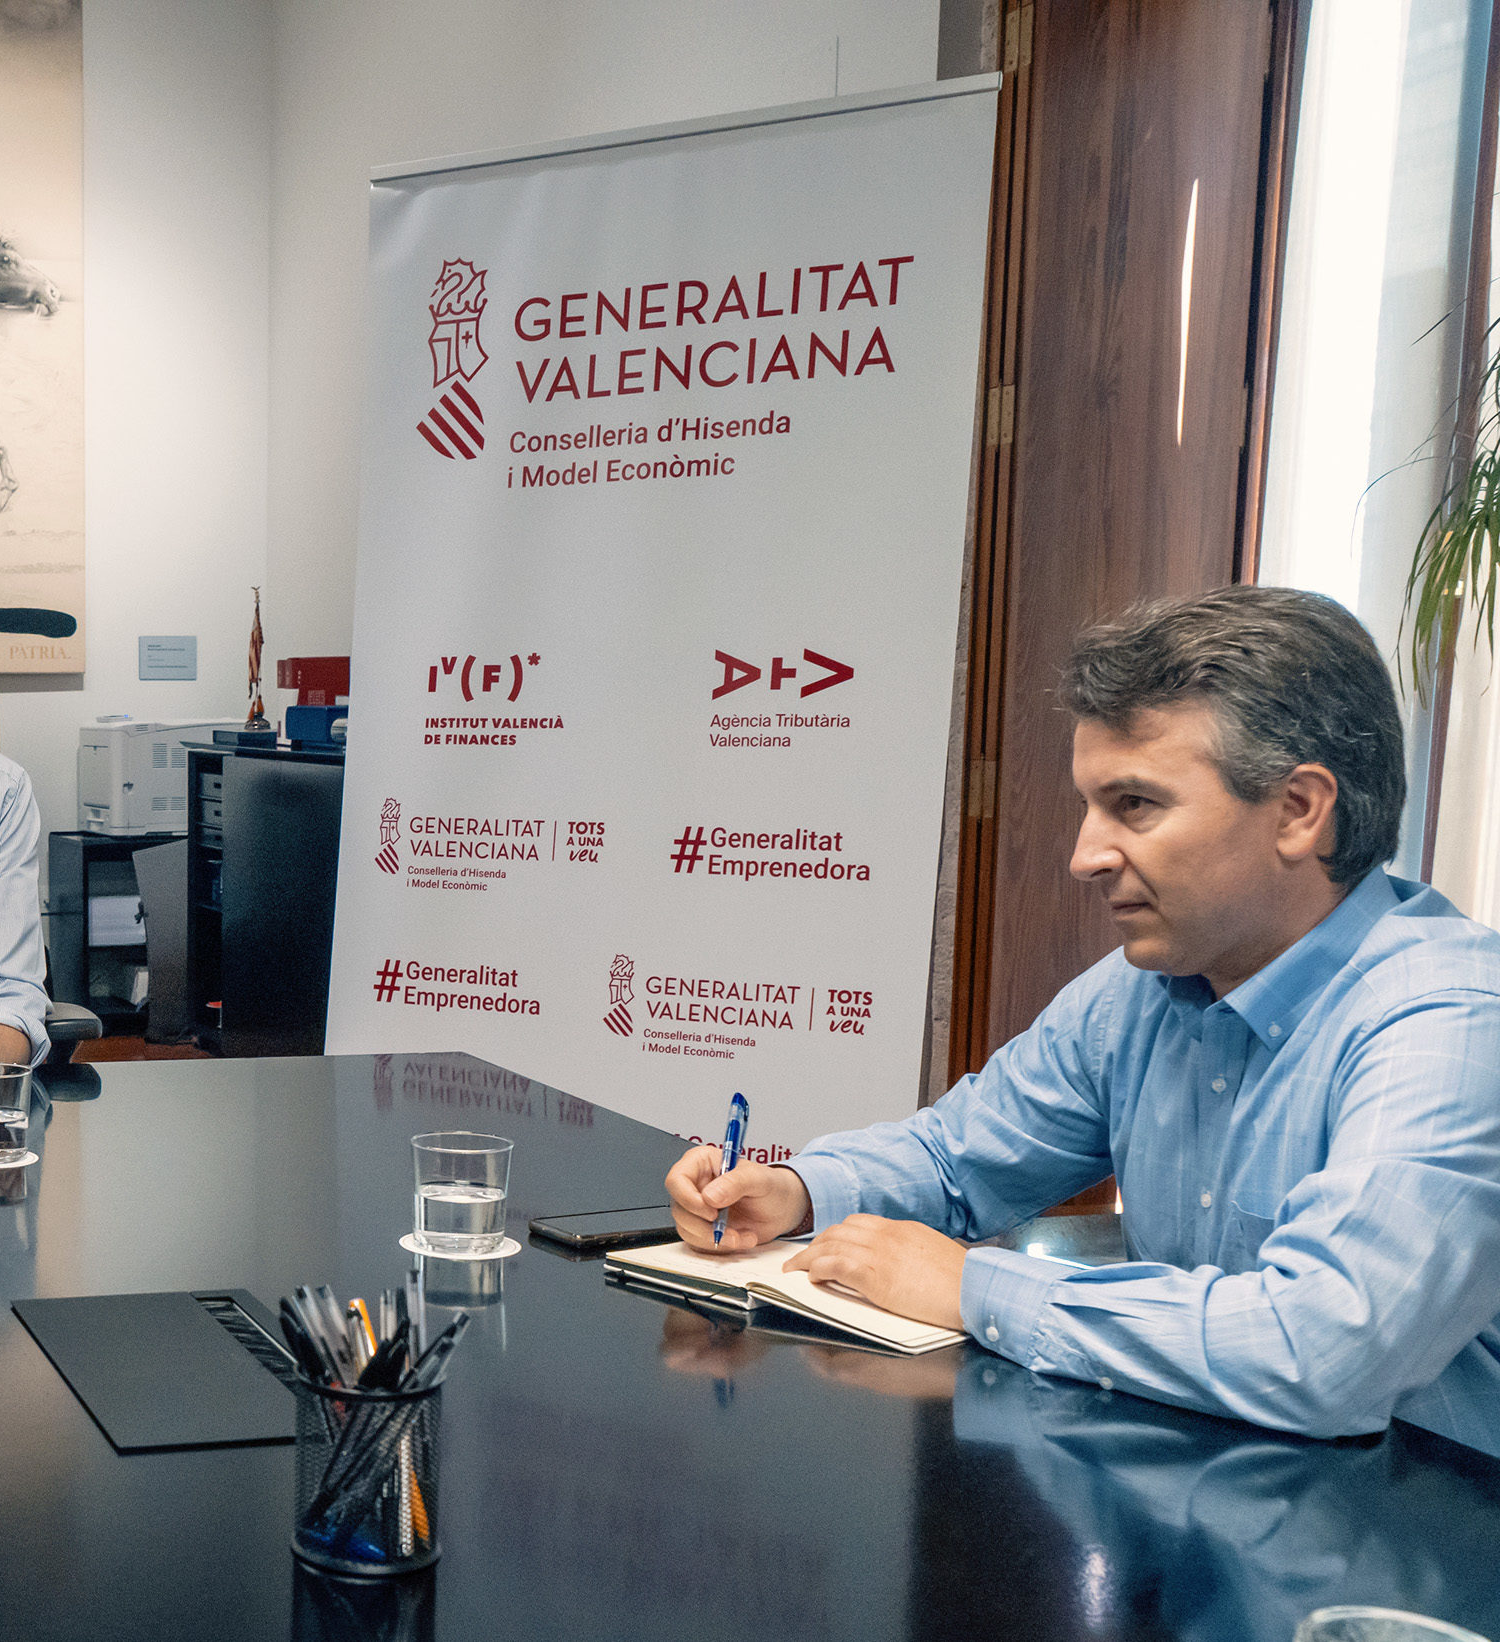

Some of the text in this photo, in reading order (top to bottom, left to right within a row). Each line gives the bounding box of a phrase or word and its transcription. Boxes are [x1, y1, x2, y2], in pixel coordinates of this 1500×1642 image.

[514, 255, 915, 342] GENERALITAT
[516, 326, 895, 403] VALENCIANA
[510, 422, 648, 453] Conselleria
[508, 453, 735, 488] i Model Econòmic
[425, 715, 564, 729] INSTITUT VALENCIÀ
[710, 714, 851, 731] Agència Tributària
[424, 734, 516, 746] DE FINANCES
[710, 734, 791, 747] Valenciana
[410, 816, 545, 837] GENERALITAT
[568, 821, 605, 835] TOTS
[566, 836, 603, 847] A UNA
[411, 840, 539, 861] VALENCIANA
[569, 849, 598, 862] veu
[408, 866, 458, 876] Conselleria
[708, 854, 870, 882] Emprenedora
[412, 879, 439, 888] Model
[646, 976, 800, 1004] GENERALITAT
[828, 989, 873, 1006] TOTS
[404, 986, 540, 1015] Emprenedora
[647, 1001, 793, 1030] VALENCIANA
[826, 1005, 871, 1018] A UNA
[829, 1019, 864, 1035] veu
[644, 1029, 701, 1042] Conselleria
[648, 1043, 680, 1054] Model
[684, 1046, 734, 1059] Econòmic
